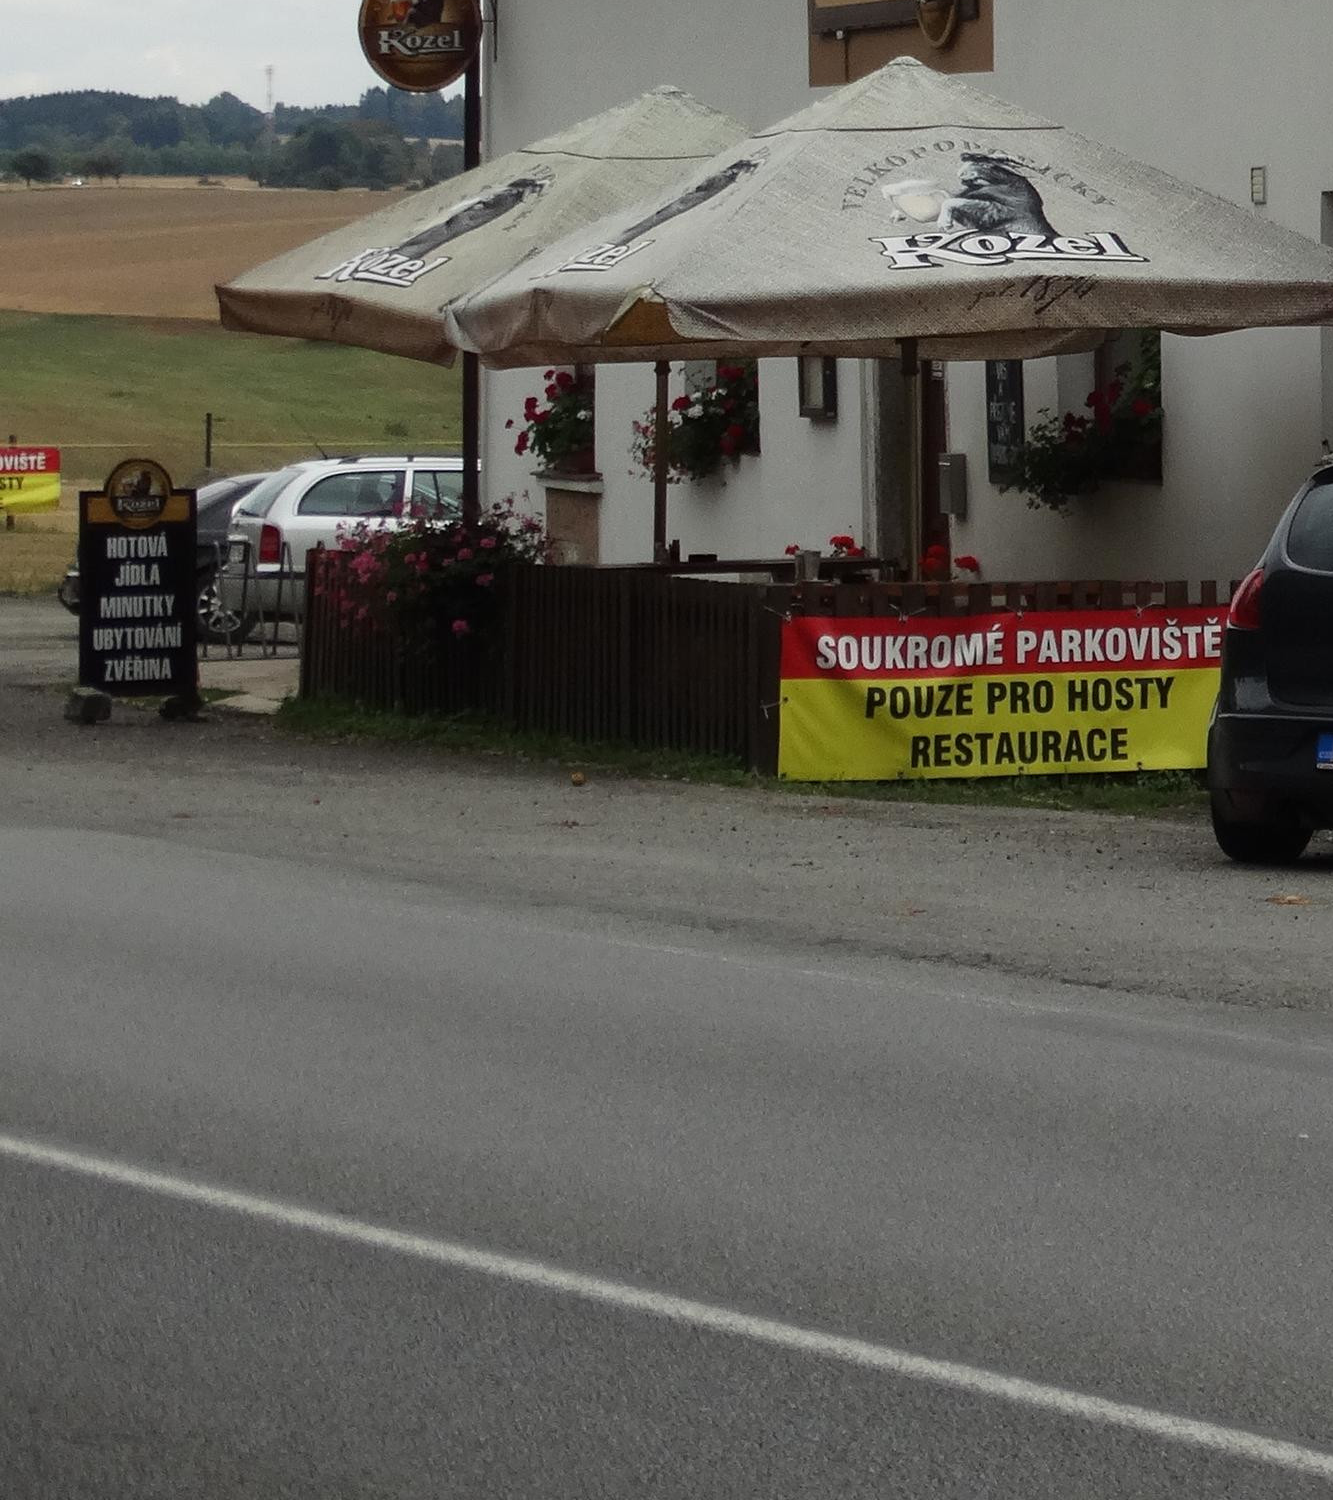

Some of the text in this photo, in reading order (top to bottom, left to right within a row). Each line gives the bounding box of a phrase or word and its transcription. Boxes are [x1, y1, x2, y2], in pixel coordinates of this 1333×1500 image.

[378, 29, 466, 57] Kozel
[868, 229, 1151, 270] Kozel
[314, 247, 452, 288] Kozel
[106, 531, 168, 559] HOTOVÁ
[114, 561, 161, 586] JÍDLA
[100, 595, 175, 618] MINUTKY
[92, 622, 182, 651] UBYTOVÁNÍ
[816, 617, 1222, 670] SOUKROMÉ PARKOVIŠTĚ
[104, 655, 172, 682] ZVĚŘINA
[865, 677, 1175, 719] POUZE PRO HOSTY
[911, 728, 1128, 769] RESTAURACE
